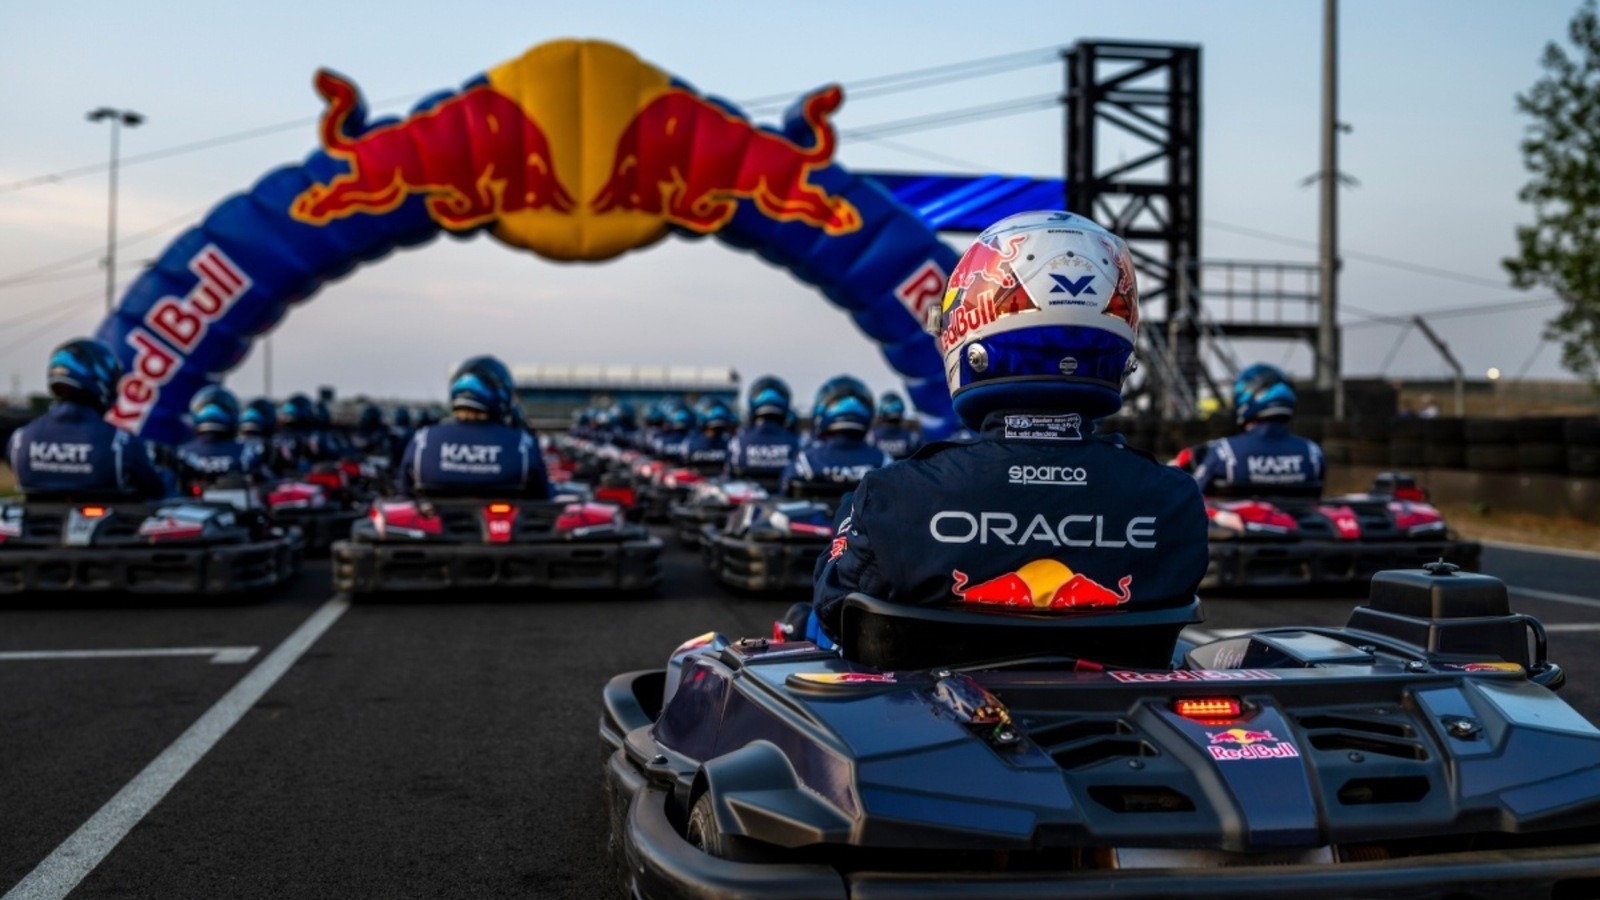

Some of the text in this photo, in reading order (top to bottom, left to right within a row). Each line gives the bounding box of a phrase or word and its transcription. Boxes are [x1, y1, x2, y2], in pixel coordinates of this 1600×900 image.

[144, 243, 254, 355] Bull
[954, 288, 997, 338] Bull
[29, 442, 93, 463] KART
[440, 443, 502, 463] KART
[1008, 464, 1087, 485] sparco
[1247, 455, 1304, 475] KART
[929, 510, 1157, 549] ORACLE
[1107, 669, 1282, 683] Red Bull
[1207, 742, 1300, 761] Red Bull
